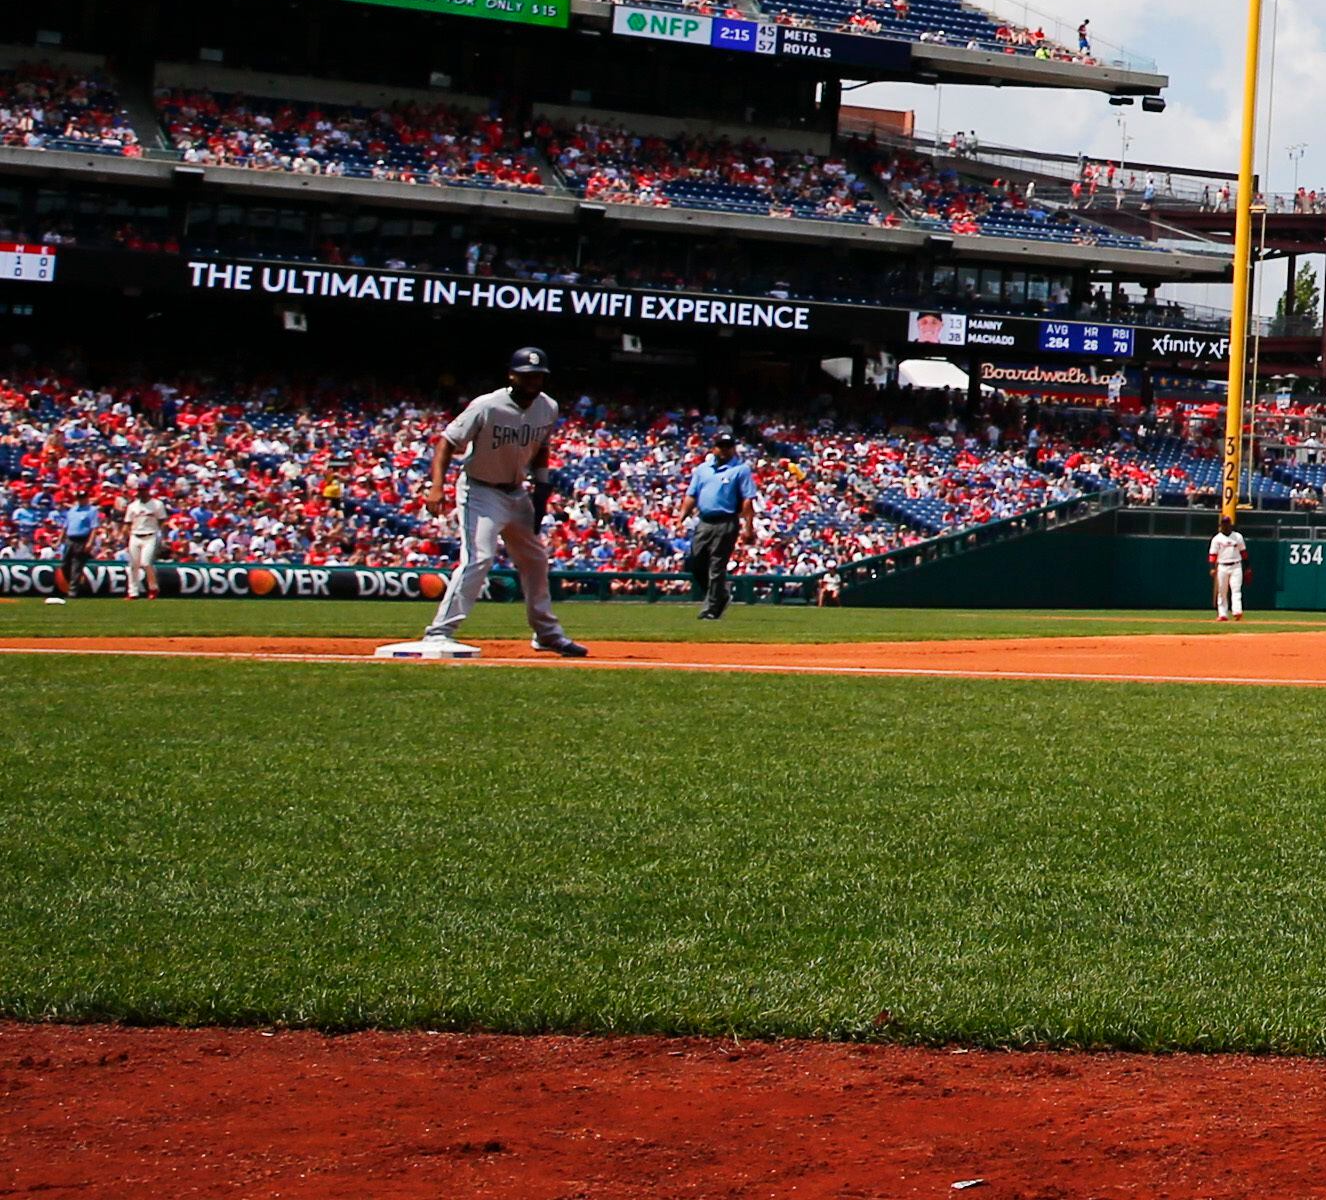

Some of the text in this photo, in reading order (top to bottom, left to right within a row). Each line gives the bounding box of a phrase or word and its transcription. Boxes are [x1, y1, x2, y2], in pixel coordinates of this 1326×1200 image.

[651, 15, 699, 38] NFP
[720, 27, 750, 41] 2:15
[759, 25, 817, 43] 45 METS
[758, 40, 831, 59] 57 ROYALS
[188, 262, 810, 330] THE ULTIMATE IN-HOME WIFI EXPERIENCE
[968, 320, 1002, 331] MANNY
[1046, 324, 1129, 340] AVG HR RBI
[968, 333, 1015, 346] MACHADO
[1152, 335, 1206, 357] xfinity
[981, 363, 1088, 385] Boardwalk
[1290, 545, 1323, 565] 334
[178, 566, 330, 597] DISCOVER
